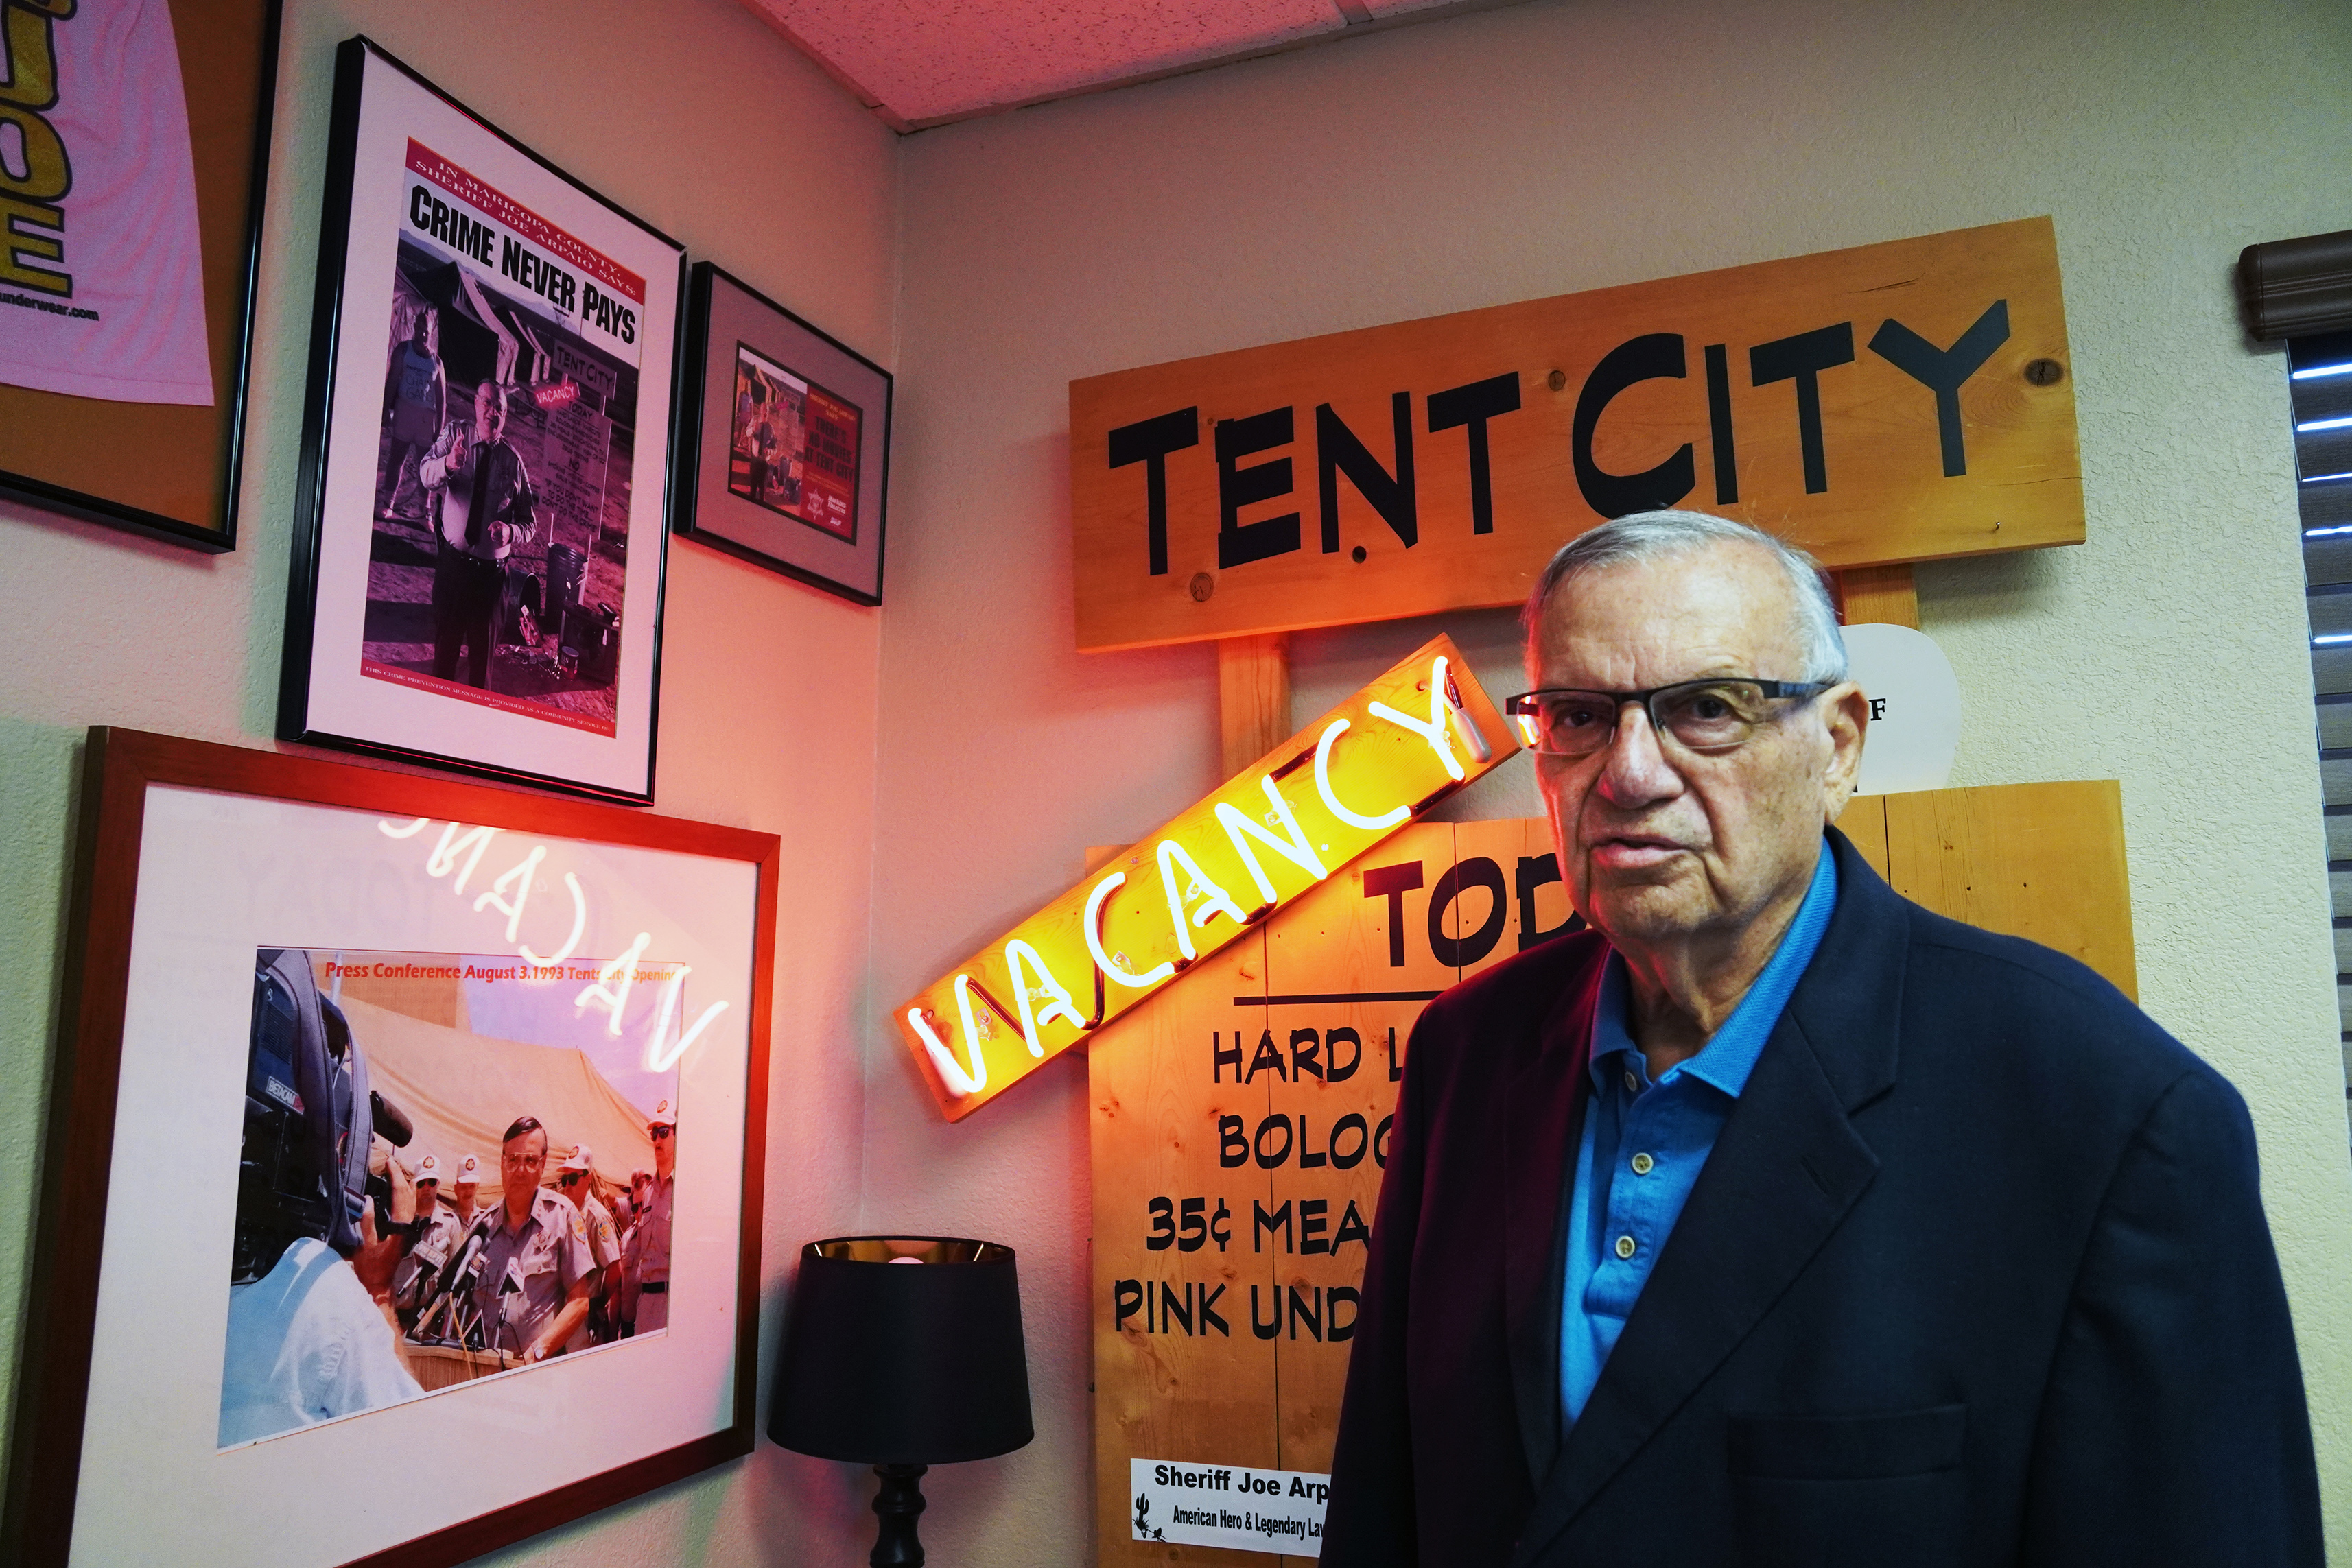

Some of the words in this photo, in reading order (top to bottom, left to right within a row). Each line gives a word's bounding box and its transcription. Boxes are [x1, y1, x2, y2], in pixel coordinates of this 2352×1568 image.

[416, 161, 493, 208] SHERIFF
[499, 211, 529, 233] JOE
[537, 233, 593, 269] ARPAIO
[440, 162, 458, 178] IN
[465, 178, 549, 234] MARICOPA
[410, 185, 495, 268] CRIME
[501, 234, 576, 313] NEVER
[583, 281, 635, 344] PAYS
[536, 386, 574, 404] VACANCY
[557, 346, 585, 375] TENT
[586, 364, 613, 390] CITY
[569, 401, 592, 420] TODAY
[1109, 370, 1522, 575] TENT
[1571, 298, 2010, 521] CITY
[365, 666, 381, 674] THIS
[384, 670, 406, 681] CRIME
[408, 676, 451, 691] PREVENTION
[452, 688, 482, 700] MESSAGE
[492, 698, 524, 710] PROVIDED
[541, 711, 576, 723] COMMUNITY
[577, 720, 600, 729] SERVICE
[908, 656, 1465, 1093] VACANCY
[1363, 853, 1588, 967] TOD
[325, 962, 368, 978] Press
[373, 962, 460, 979] Conference
[464, 964, 515, 983] August
[1213, 1027, 1361, 1084] HARD
[1146, 1196, 1231, 1252] 35¢
[1253, 1199, 1371, 1257] MEA
[1114, 1279, 1230, 1338] PINK
[1251, 1285, 1361, 1343] UND
[1155, 1464, 1231, 1491] Sheriff
[1237, 1472, 1281, 1496] Joe
[1288, 1476, 1330, 1505] Arp
[1173, 1505, 1217, 1528] American
[1219, 1509, 1242, 1530] Hero
[1245, 1511, 1253, 1531] &
[1255, 1512, 1305, 1541] Legendary
